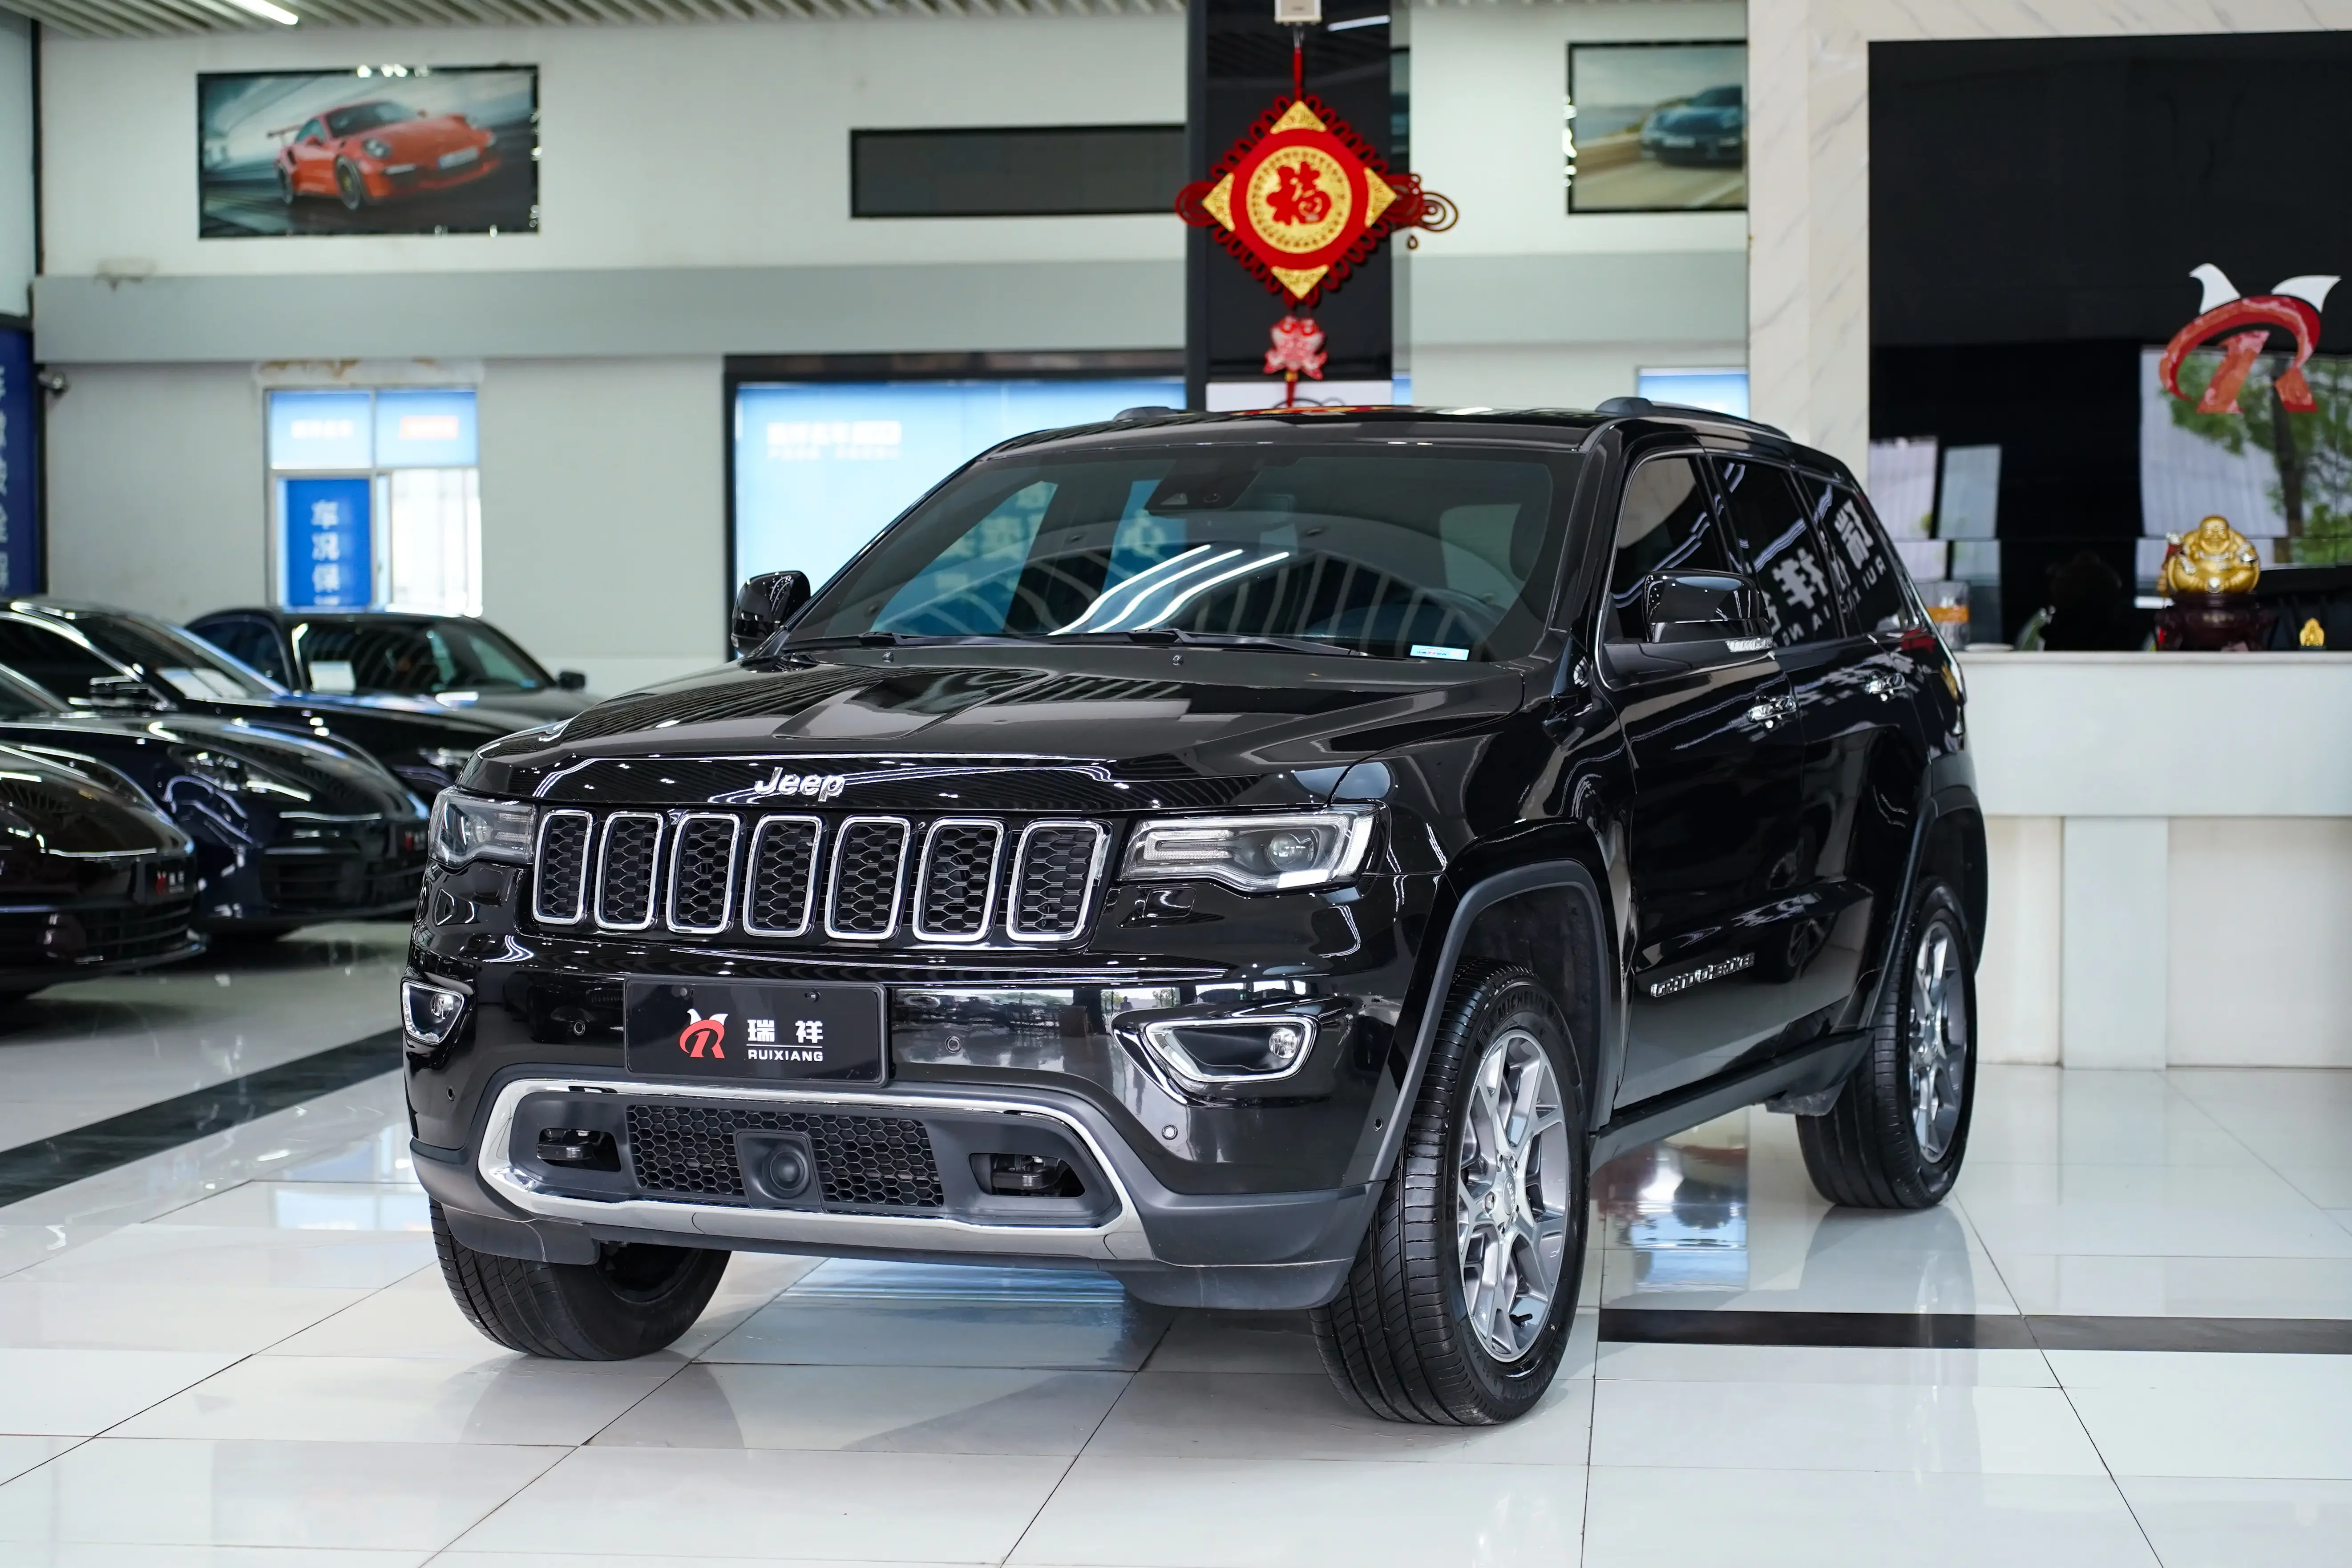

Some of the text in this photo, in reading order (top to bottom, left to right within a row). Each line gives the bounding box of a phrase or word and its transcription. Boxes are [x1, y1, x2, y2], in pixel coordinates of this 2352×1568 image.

[1266, 161, 1332, 226] 福
[754, 767, 845, 802] Jeep
[1497, 990, 1546, 1020] MICHELIN
[747, 1019, 823, 1043] 瑞祥
[748, 1049, 823, 1062] RUIXIANG
